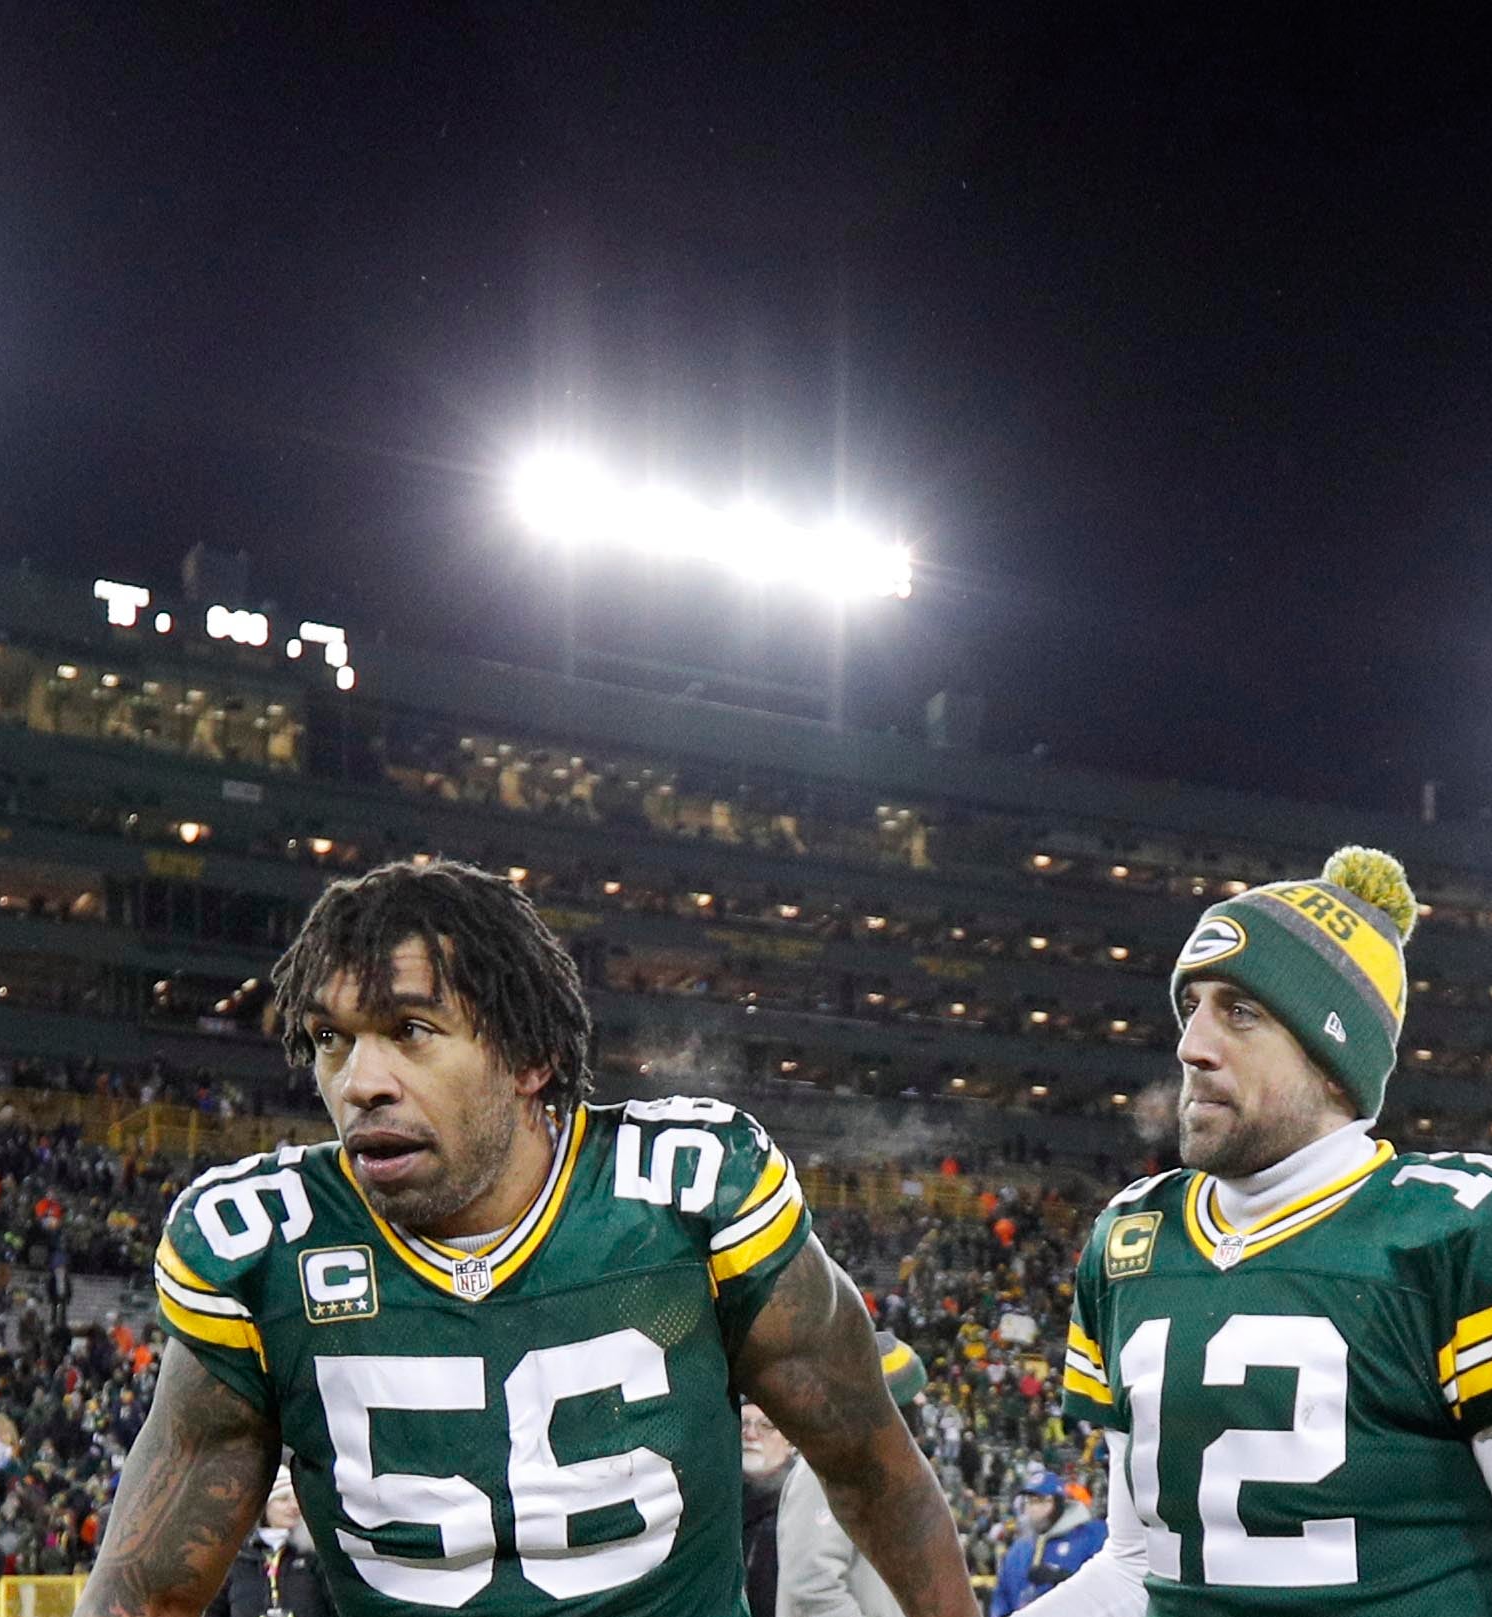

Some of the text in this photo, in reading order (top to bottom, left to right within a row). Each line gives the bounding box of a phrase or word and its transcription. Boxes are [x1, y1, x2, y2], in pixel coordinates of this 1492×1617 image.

[1110, 1216, 1155, 1259] C
[306, 1250, 369, 1302] C
[460, 1272, 486, 1292] NFL
[314, 1328, 684, 1608] 56
[1119, 1314, 1358, 1587] 12
